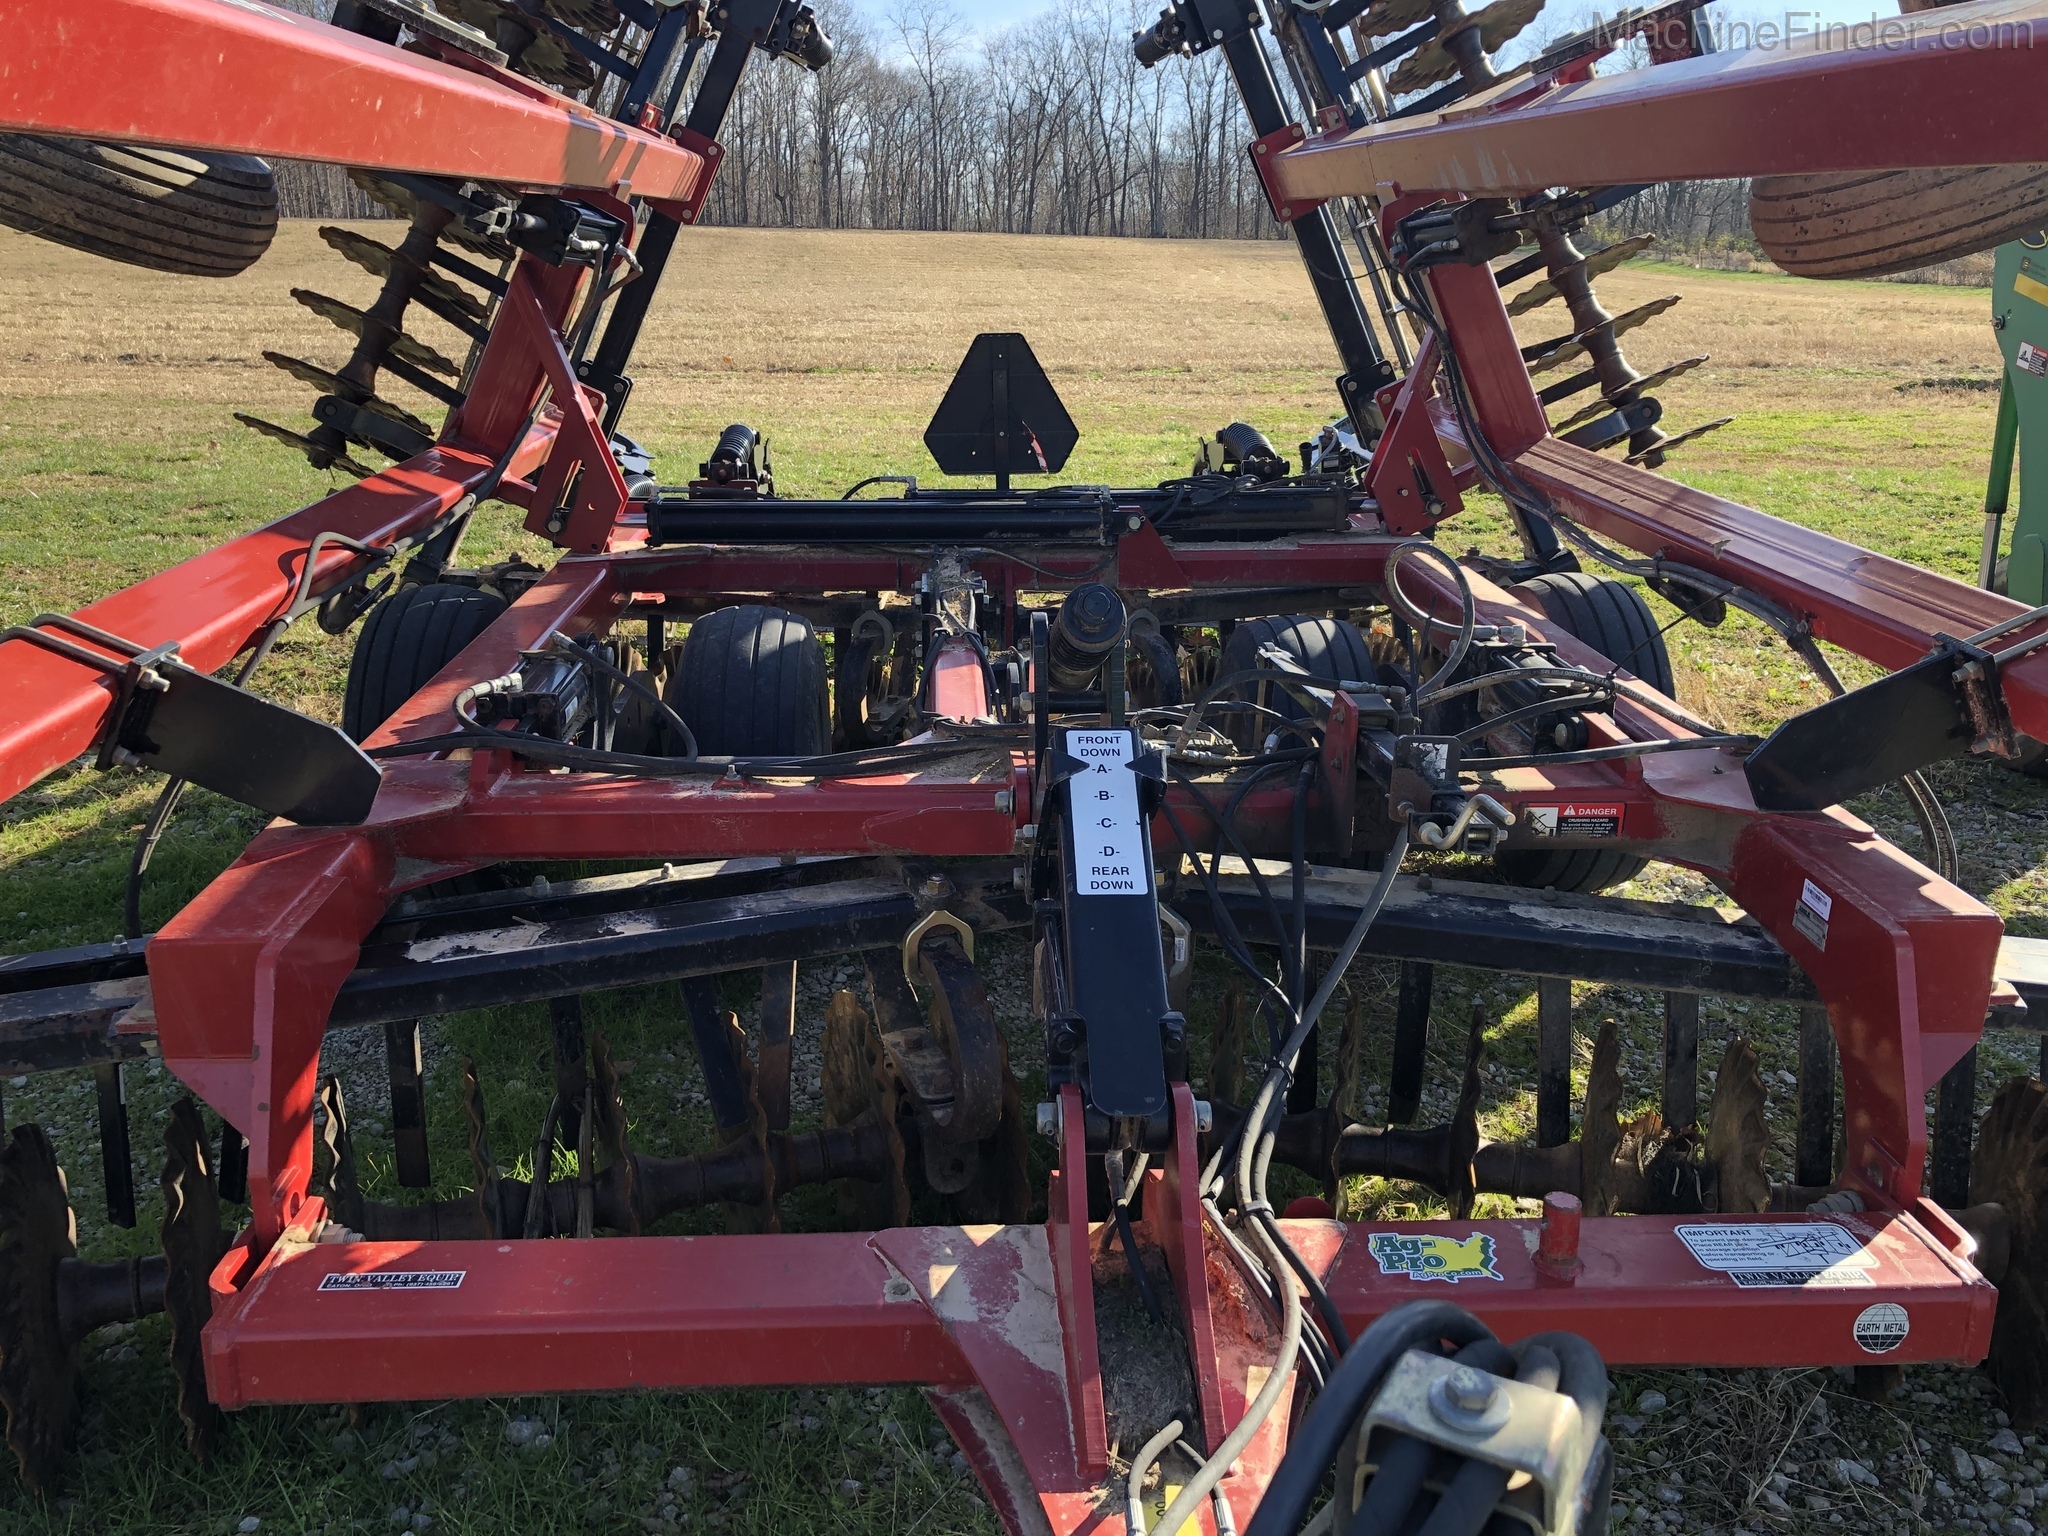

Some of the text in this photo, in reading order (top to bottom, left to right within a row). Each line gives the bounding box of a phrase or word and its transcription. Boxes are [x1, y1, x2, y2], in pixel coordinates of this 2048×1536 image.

[1077, 736, 1122, 744] FRONT
[1080, 748, 1121, 757] DOWN
[1091, 866, 1130, 876] REAR
[1090, 881, 1134, 890] DOWN
[1381, 1253, 1447, 1271] Pro
[330, 1275, 363, 1283] TWIN
[367, 1274, 415, 1282] VALLEY
[1412, 1271, 1483, 1279] AgProCo.com
[1735, 1272, 1769, 1280] TWIN
[1857, 1323, 1906, 1333] EARTH METAL
